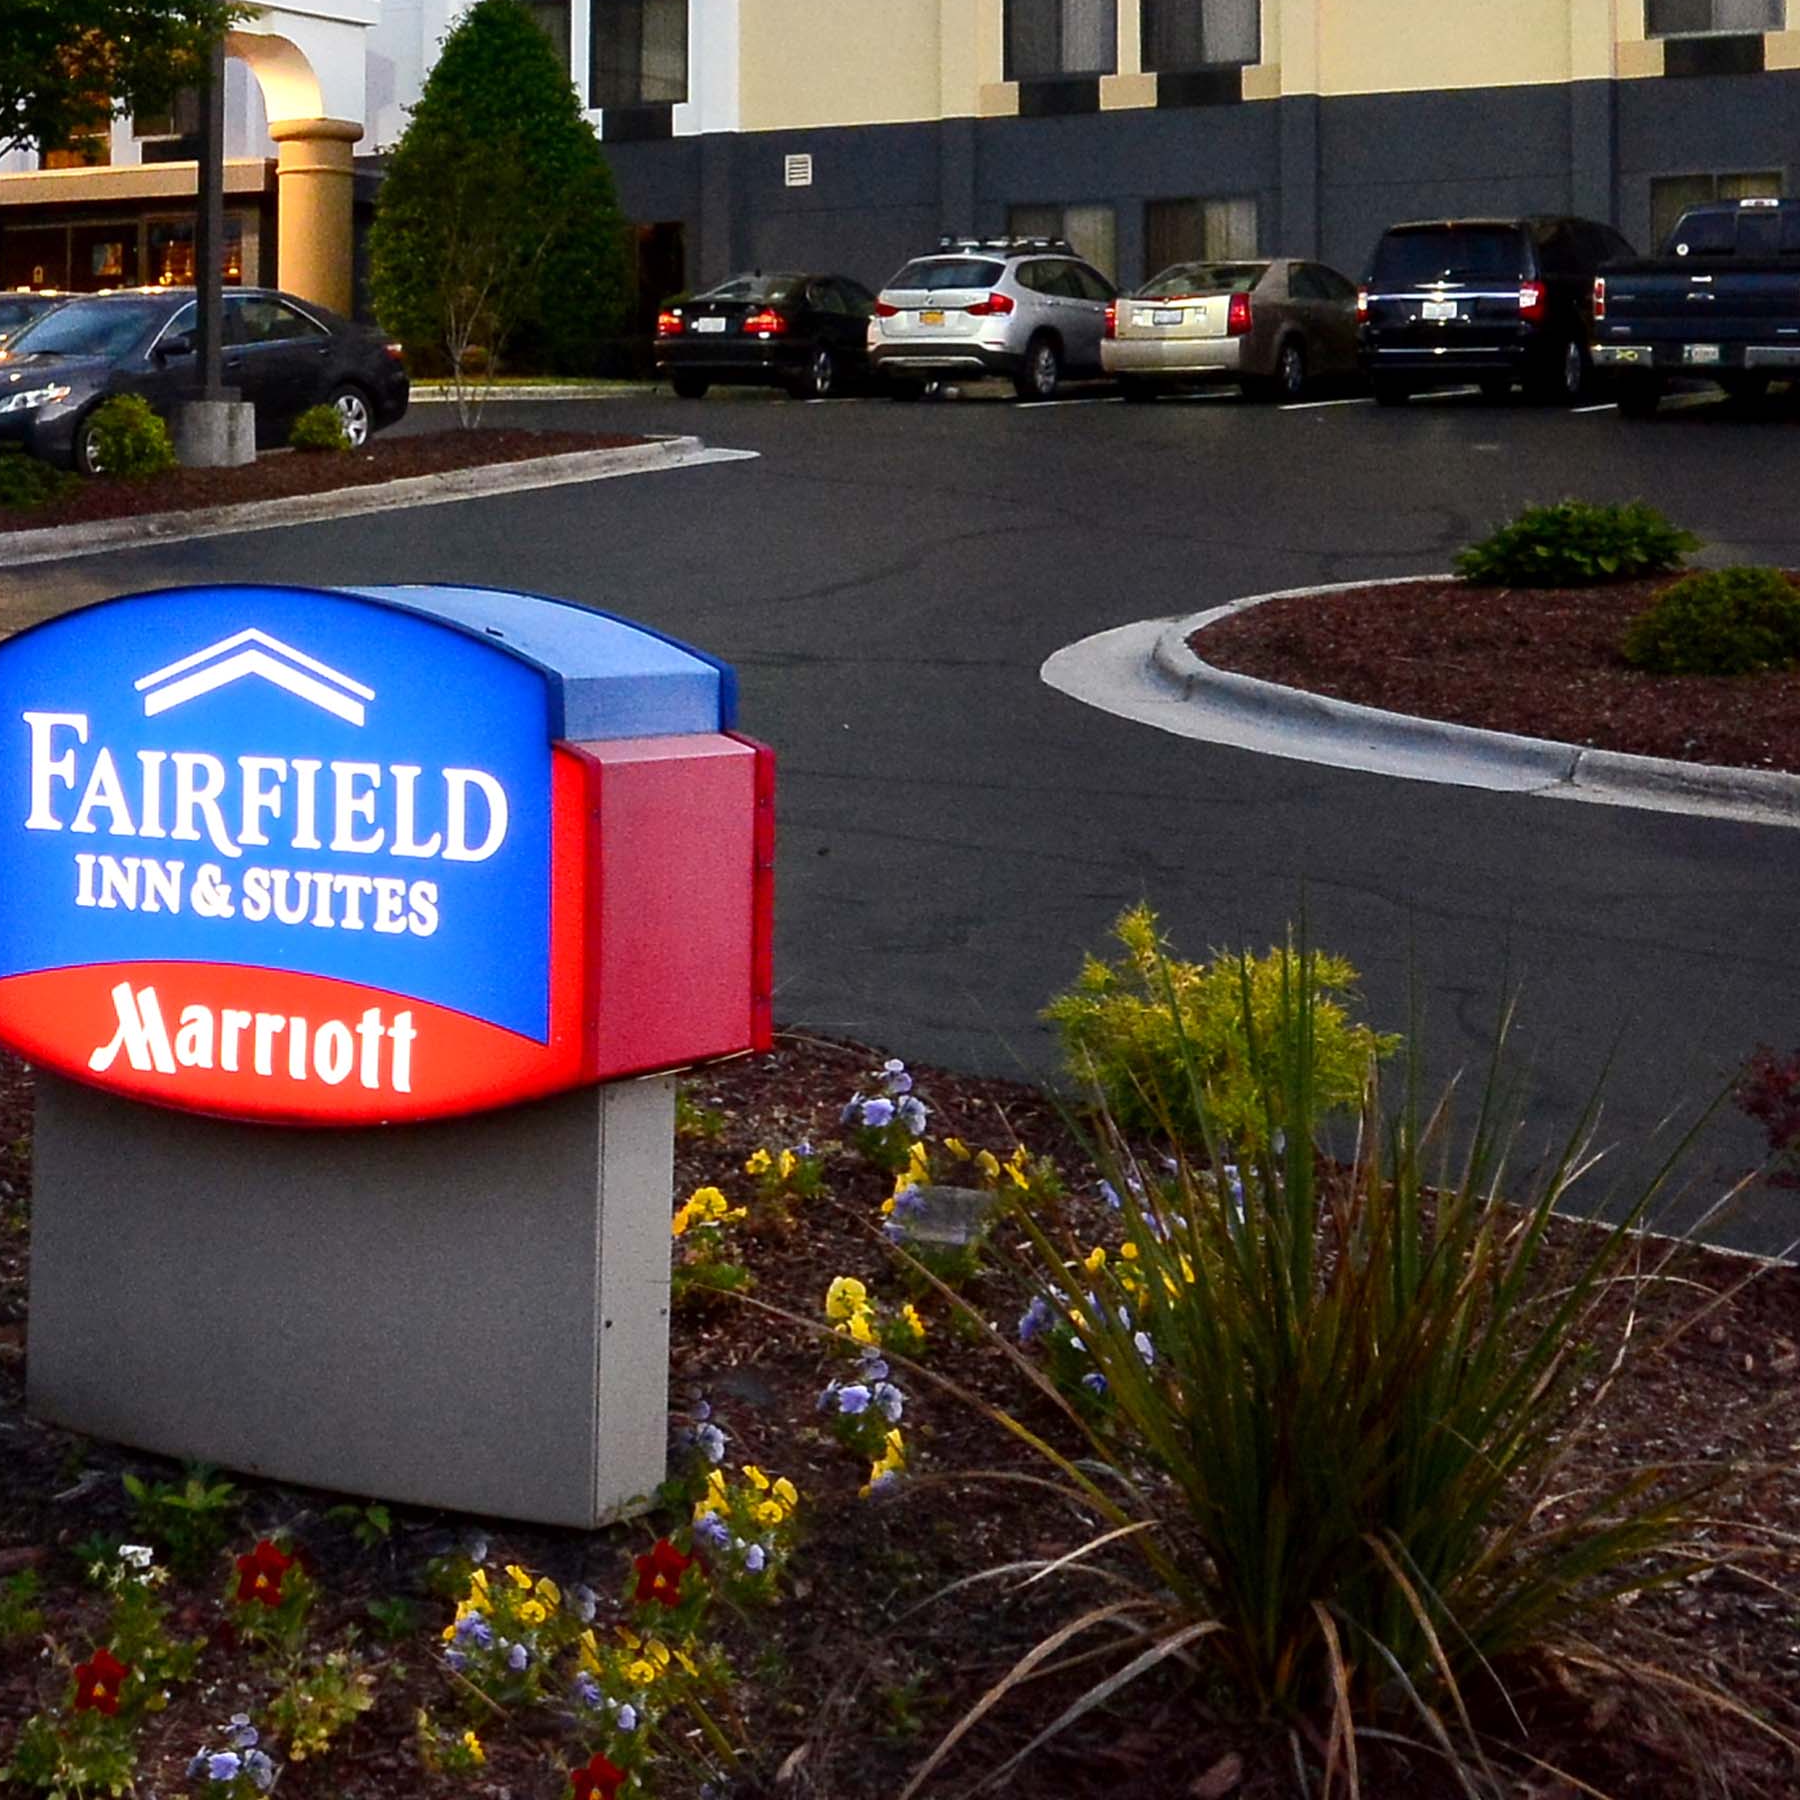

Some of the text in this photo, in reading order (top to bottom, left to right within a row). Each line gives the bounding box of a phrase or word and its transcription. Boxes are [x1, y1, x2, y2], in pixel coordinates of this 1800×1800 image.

[21, 710, 510, 863] FAIRFIELD
[73, 851, 441, 938] INN & SUITES
[86, 980, 419, 1094] Marriott
